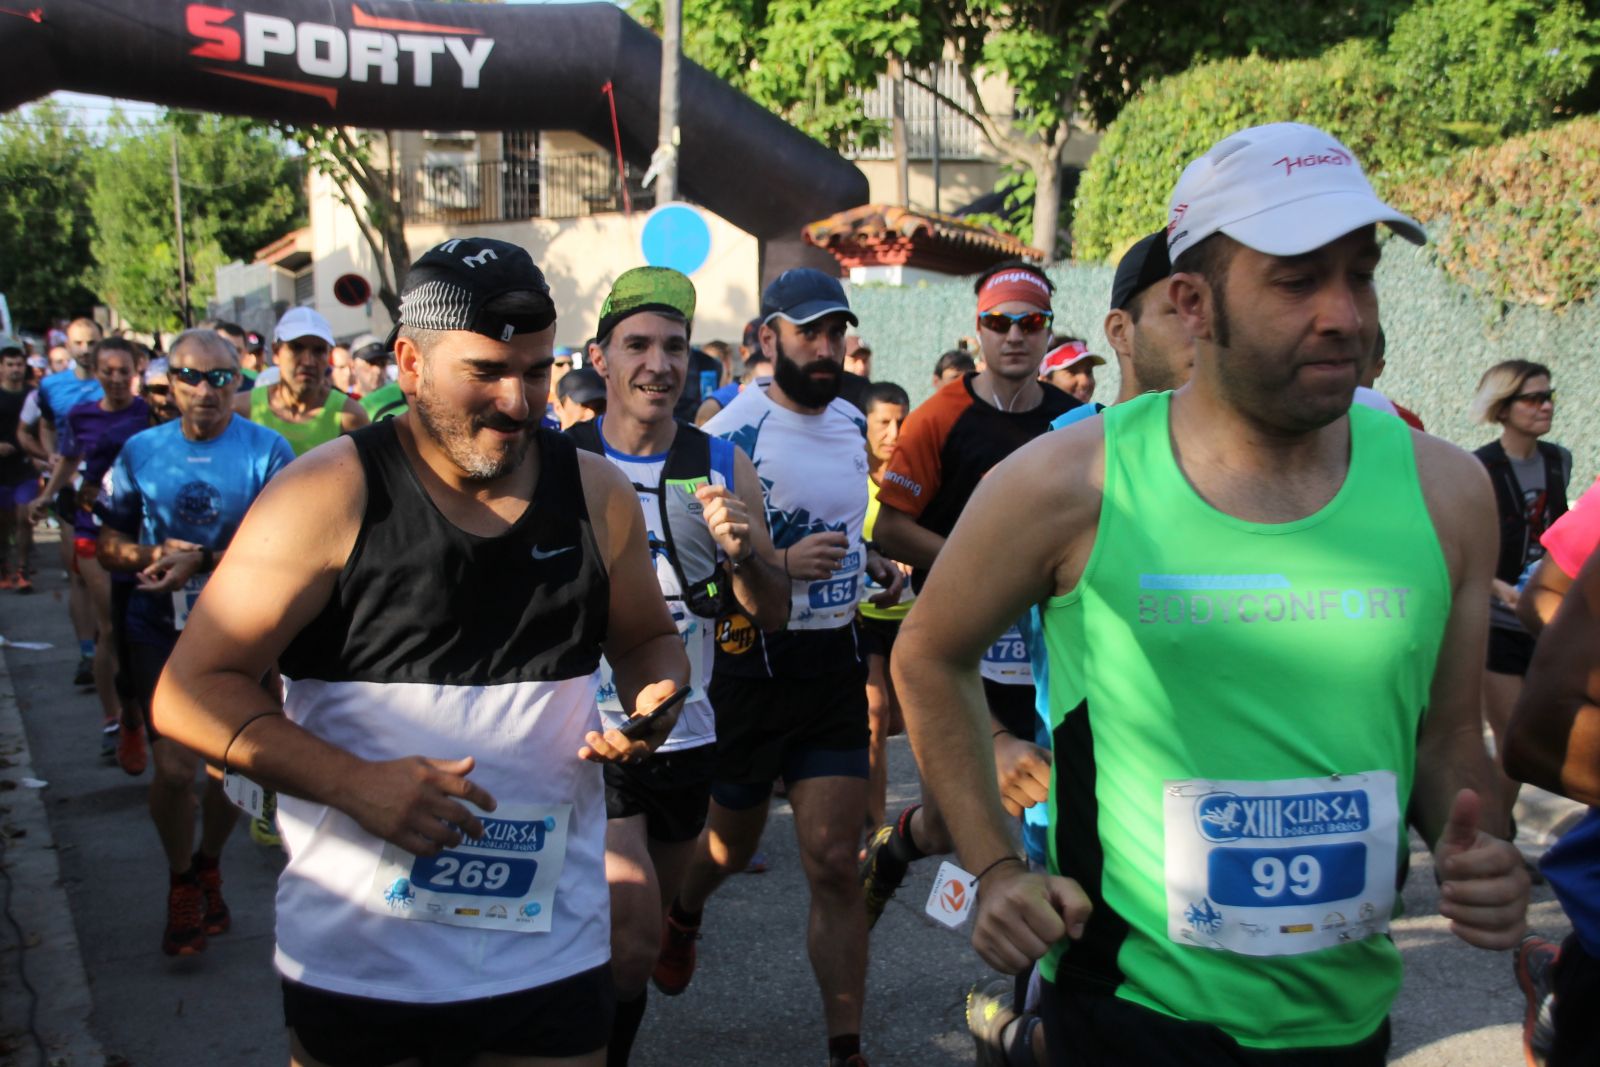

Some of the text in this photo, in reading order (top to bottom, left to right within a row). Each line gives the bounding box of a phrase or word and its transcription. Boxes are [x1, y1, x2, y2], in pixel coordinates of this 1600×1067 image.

[185, 4, 495, 90] SPORTY
[817, 580, 852, 604] 152
[1138, 587, 1411, 625] BODYCONFORT
[1282, 796, 1361, 825] CURSA
[430, 856, 511, 890] 269
[1251, 854, 1322, 898] 99
